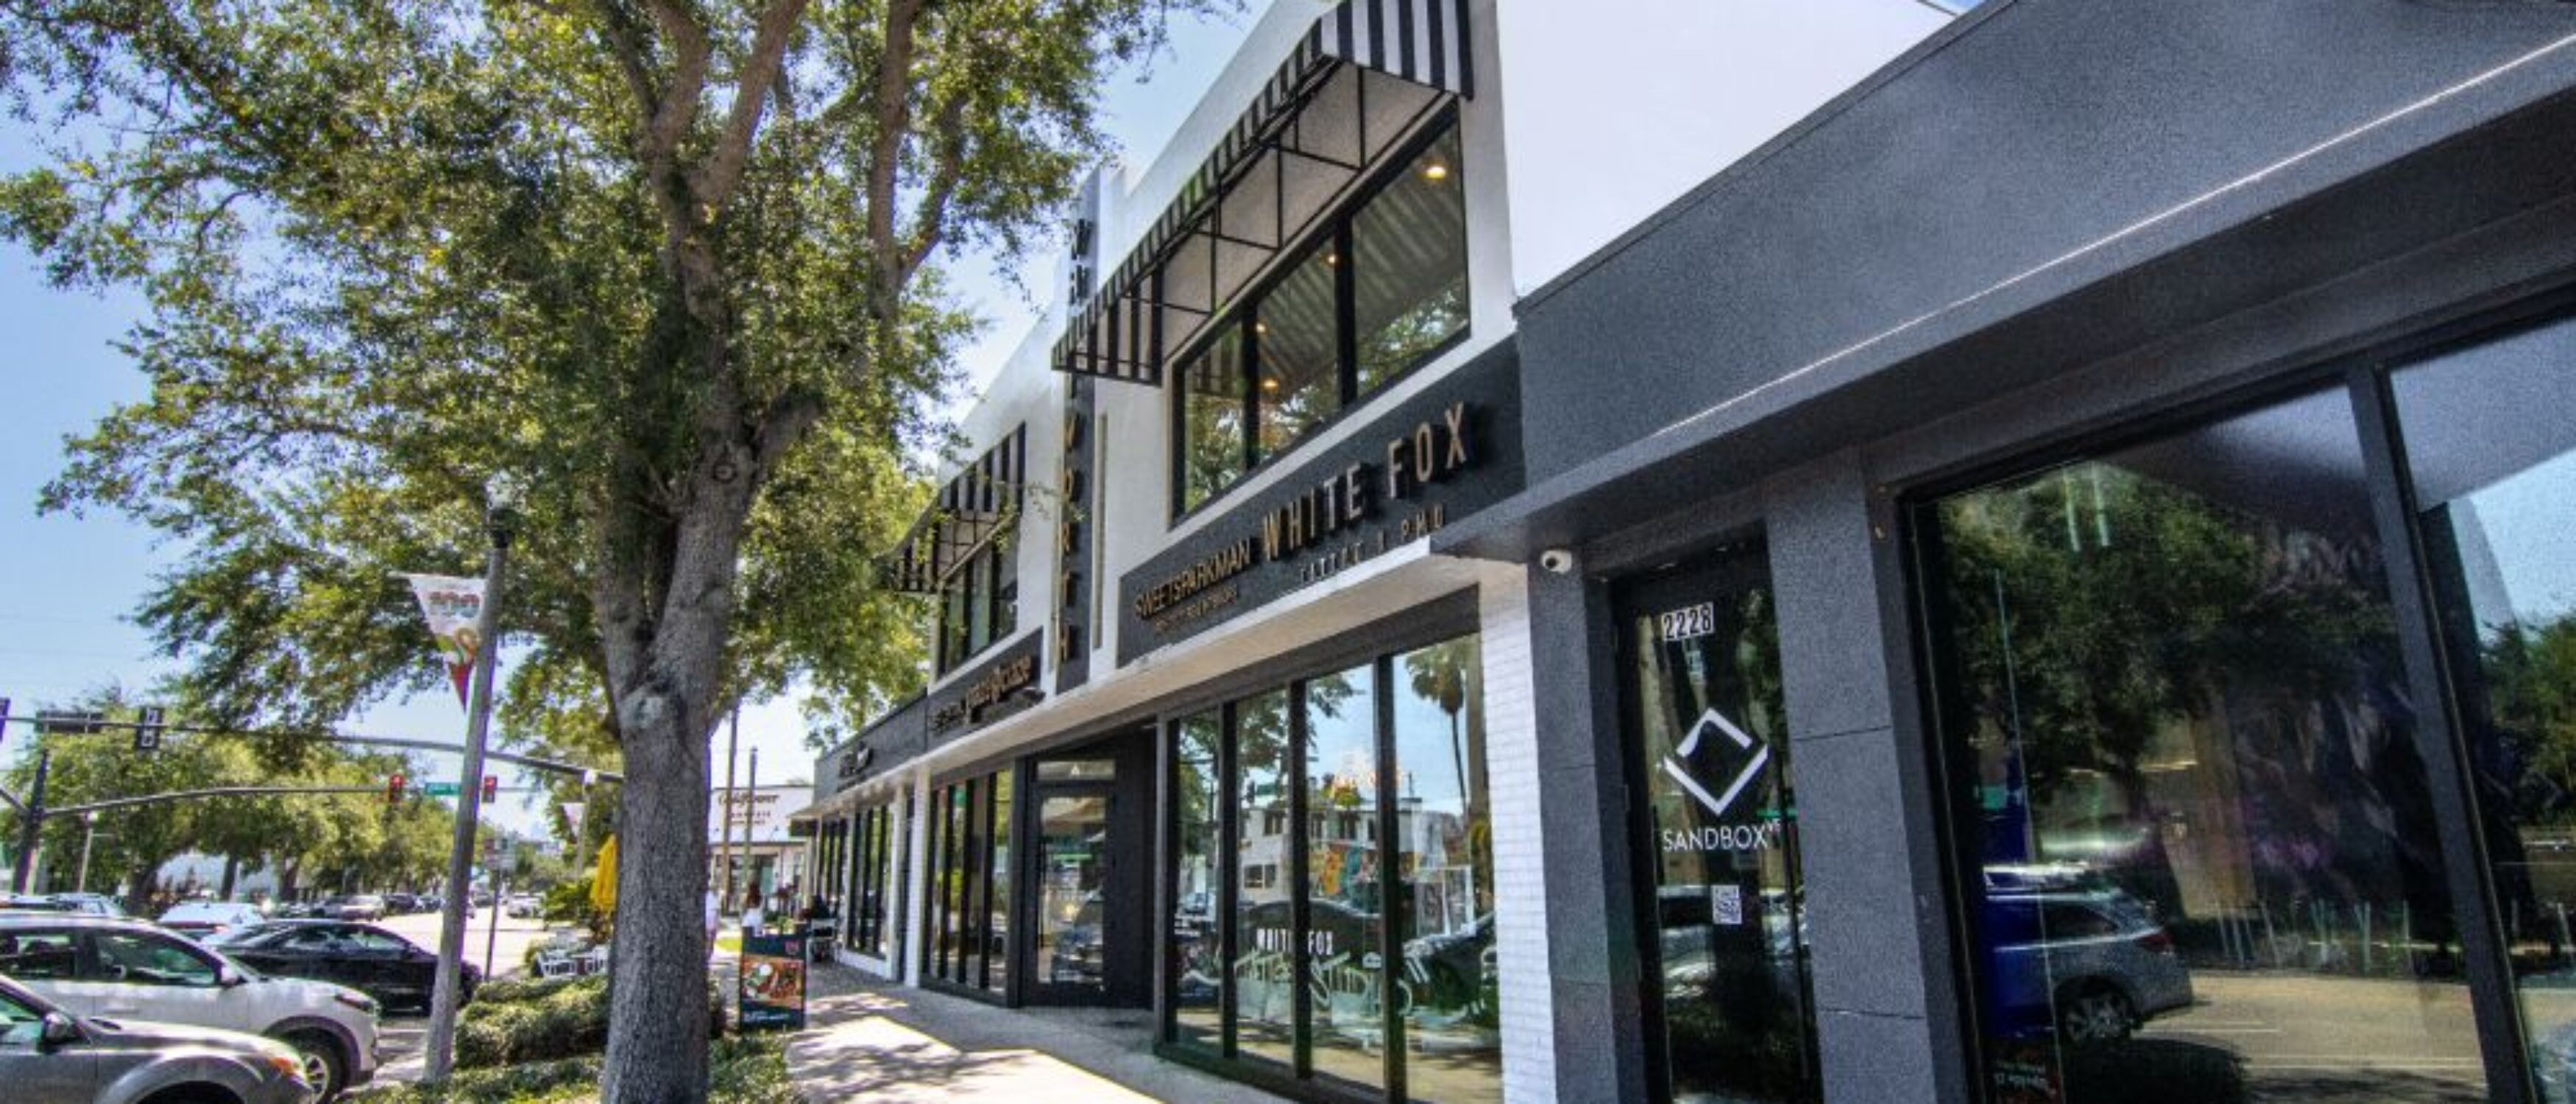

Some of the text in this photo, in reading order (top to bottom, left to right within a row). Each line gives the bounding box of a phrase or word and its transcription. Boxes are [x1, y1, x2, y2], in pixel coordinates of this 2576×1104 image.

[1263, 402, 1466, 562] WHITE FOX
[1664, 604, 1711, 639] 2228
[1663, 825, 1768, 852] SANDBOX
[1308, 930, 1334, 955] FOX
